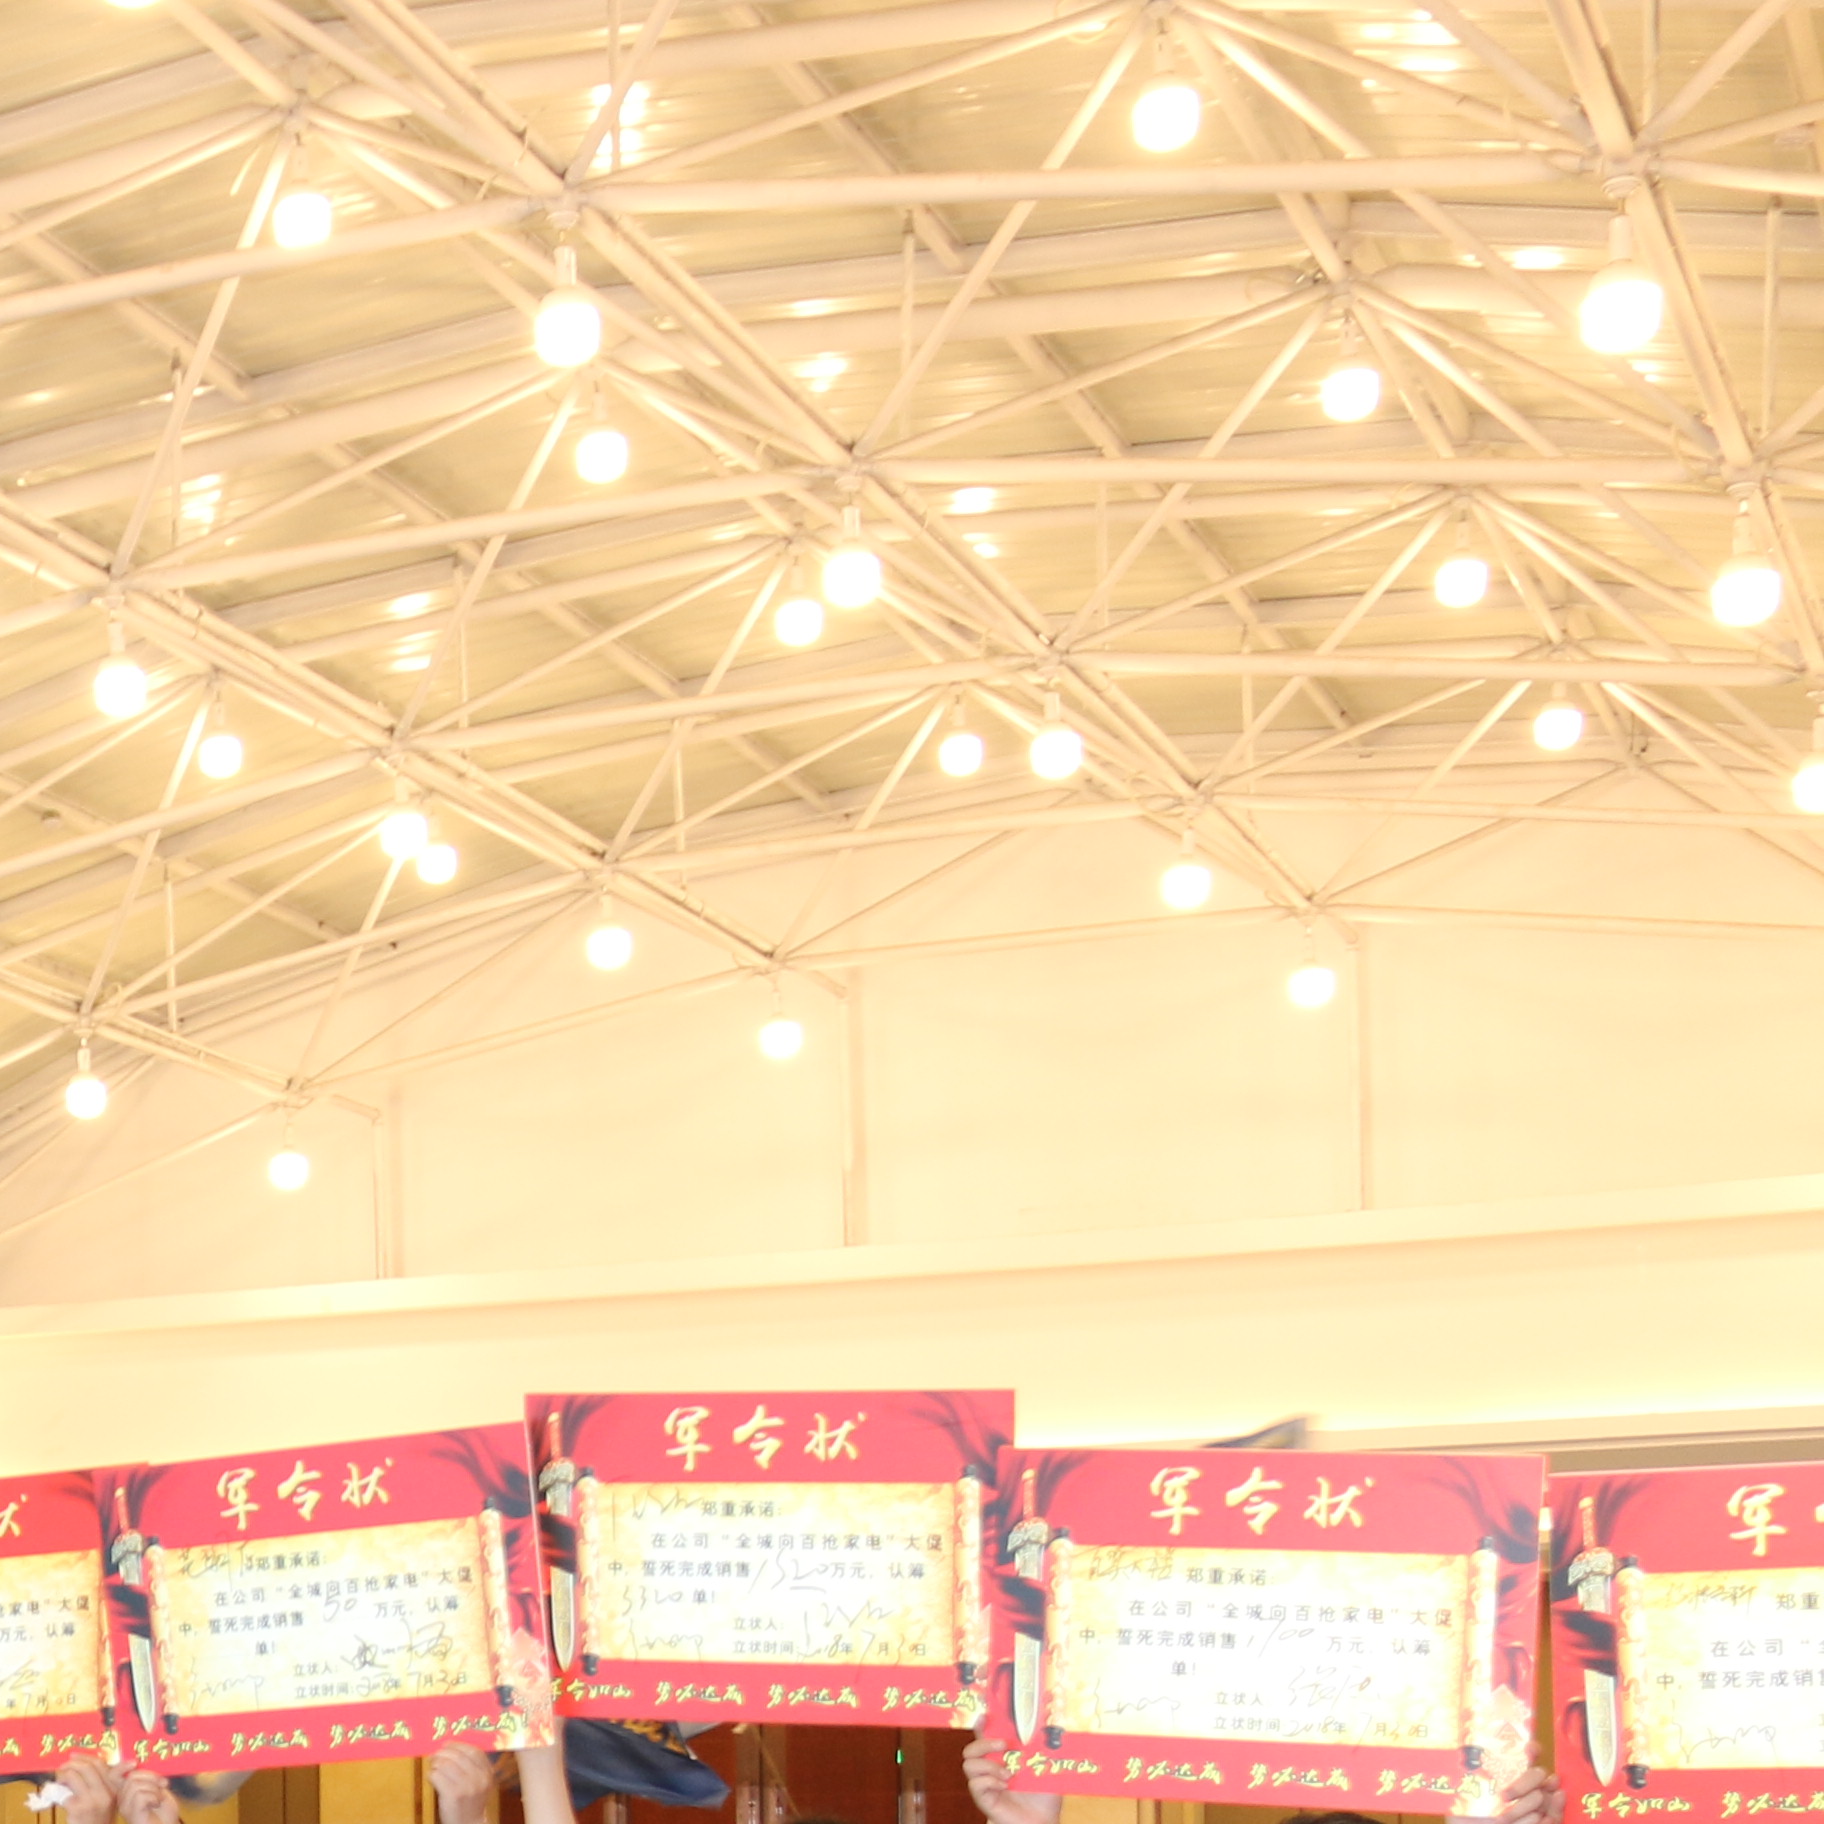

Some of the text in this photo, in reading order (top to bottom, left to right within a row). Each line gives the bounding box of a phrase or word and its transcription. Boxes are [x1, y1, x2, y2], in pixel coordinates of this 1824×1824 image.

[664, 1404, 867, 1471] 军令状
[217, 1458, 394, 1531] 军令状
[1150, 1466, 1374, 1535] 军令状
